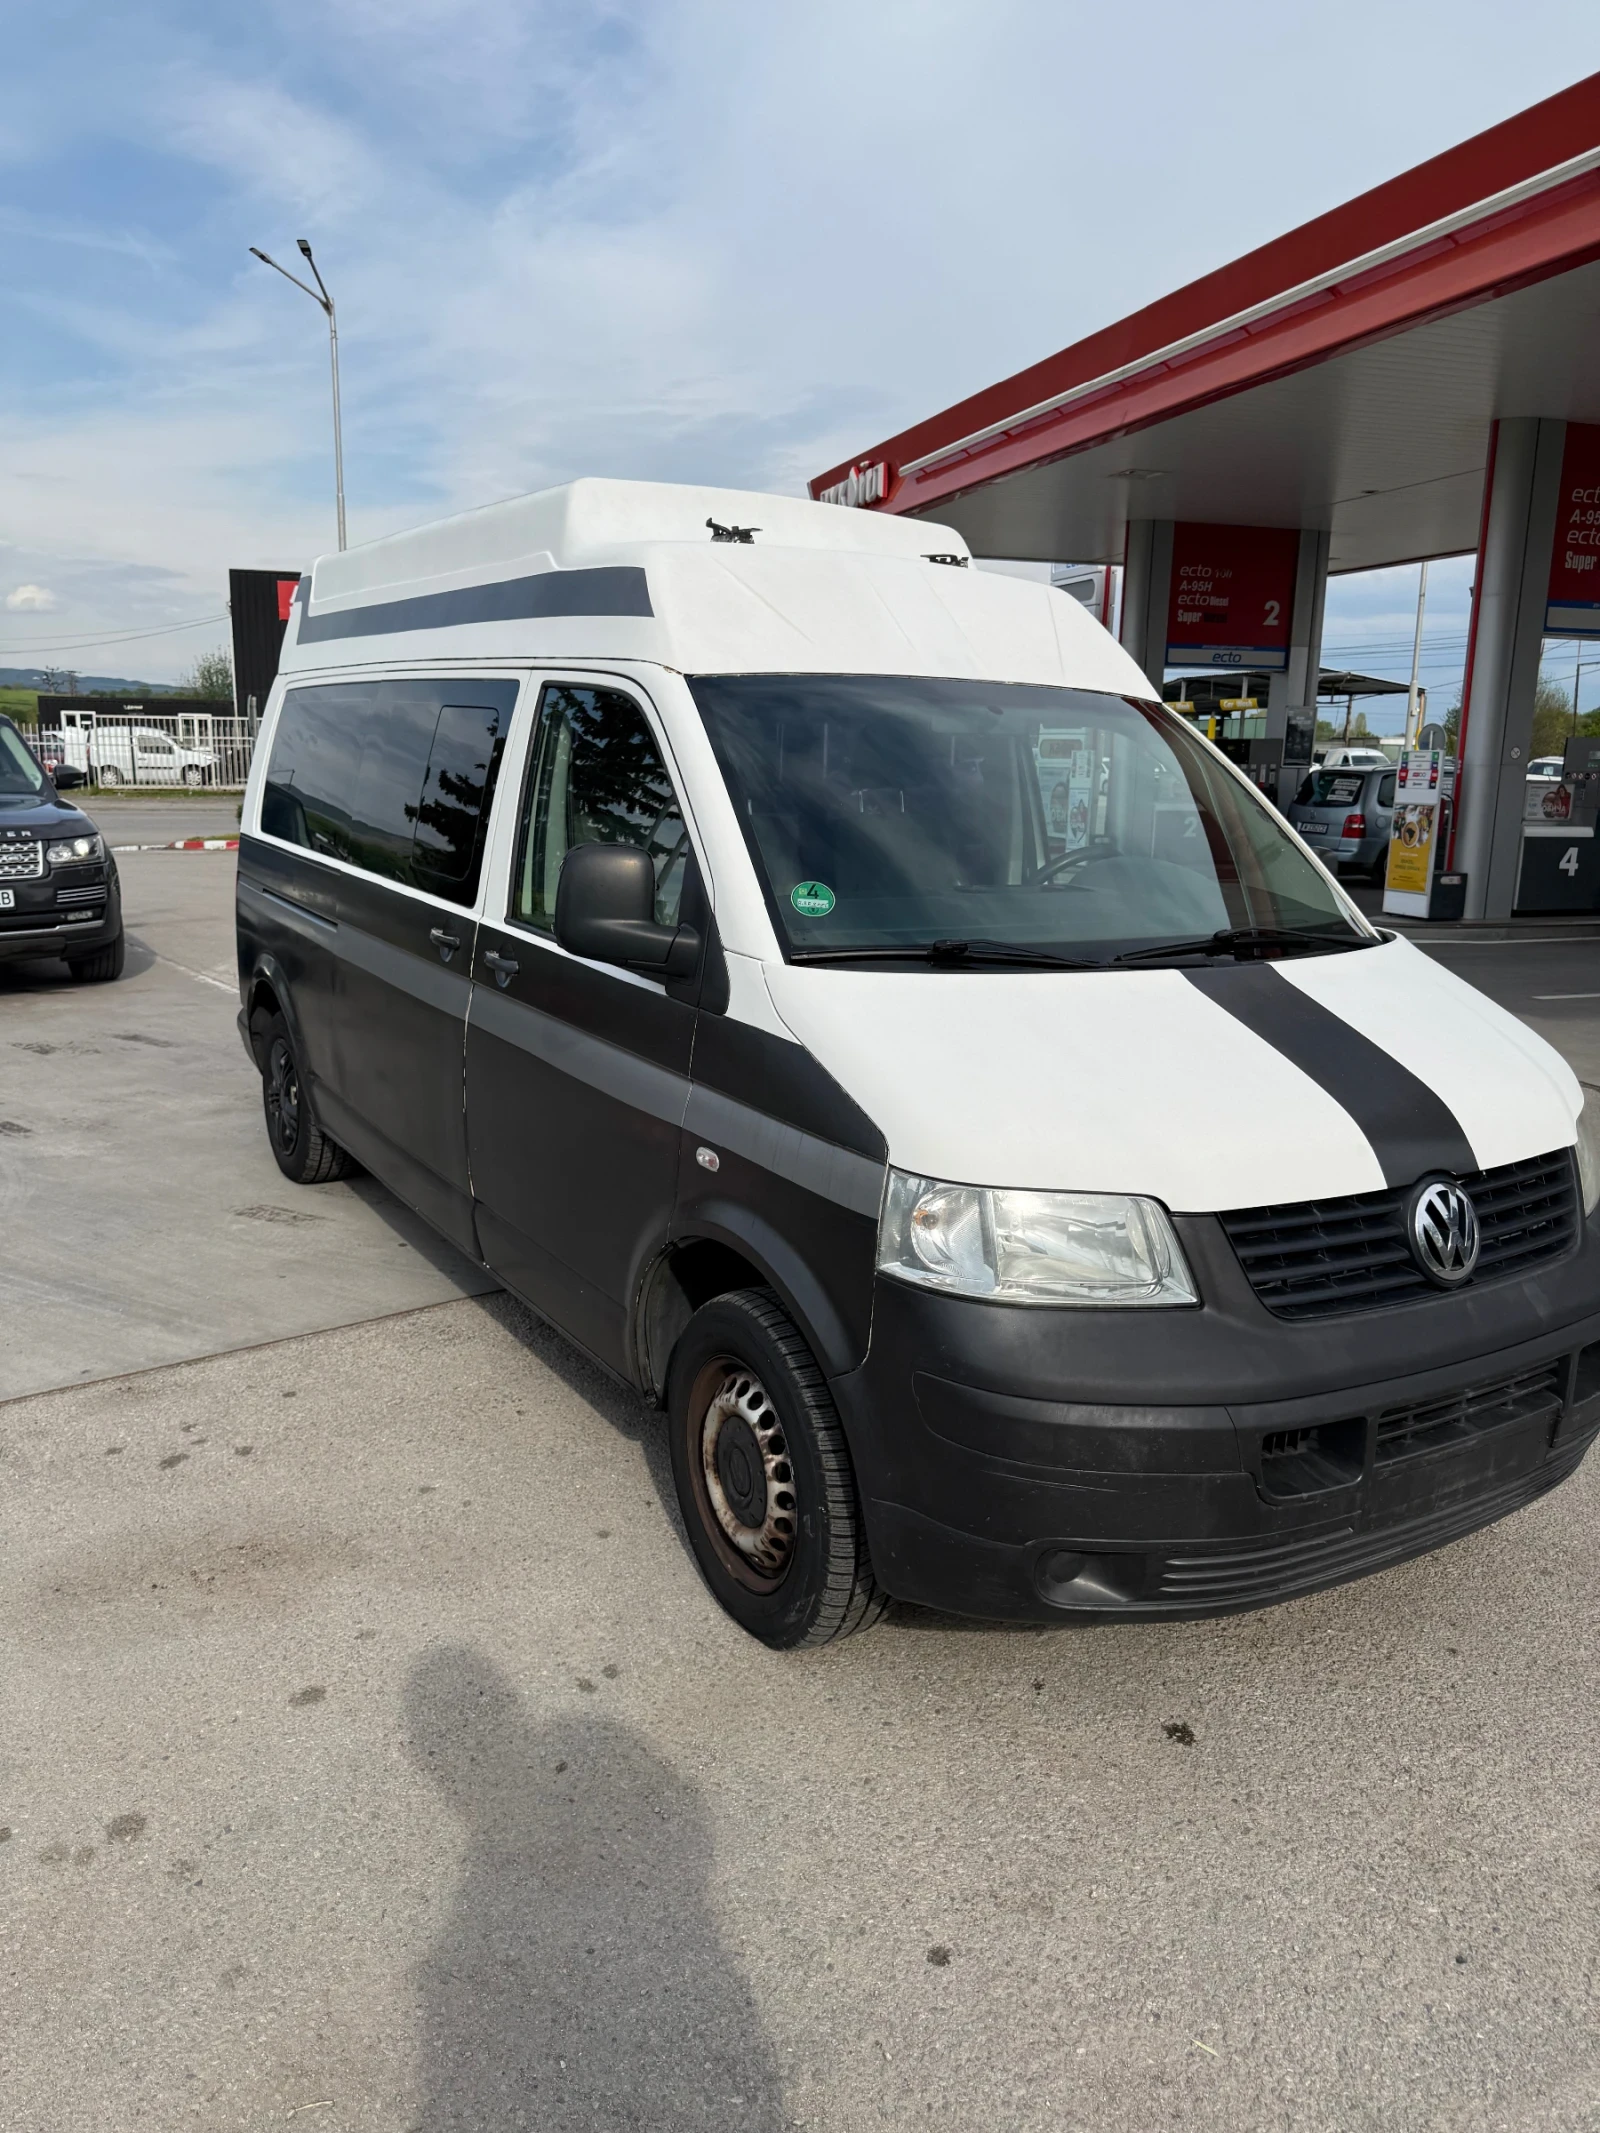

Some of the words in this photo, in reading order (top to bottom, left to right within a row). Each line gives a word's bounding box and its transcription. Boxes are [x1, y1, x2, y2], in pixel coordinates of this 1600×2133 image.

[1564, 550, 1597, 574] Super
[1180, 564, 1212, 577] ecto
[1179, 580, 1213, 592] A-95H
[1177, 609, 1202, 625] Super
[1262, 599, 1280, 626] 2
[1212, 652, 1242, 664] ecto
[1223, 700, 1234, 708] Car
[0, 830, 32, 838] ER
[1183, 816, 1198, 837] 2
[1559, 846, 1579, 877] 4
[0, 891, 12, 905] B
[807, 883, 819, 899] 4
